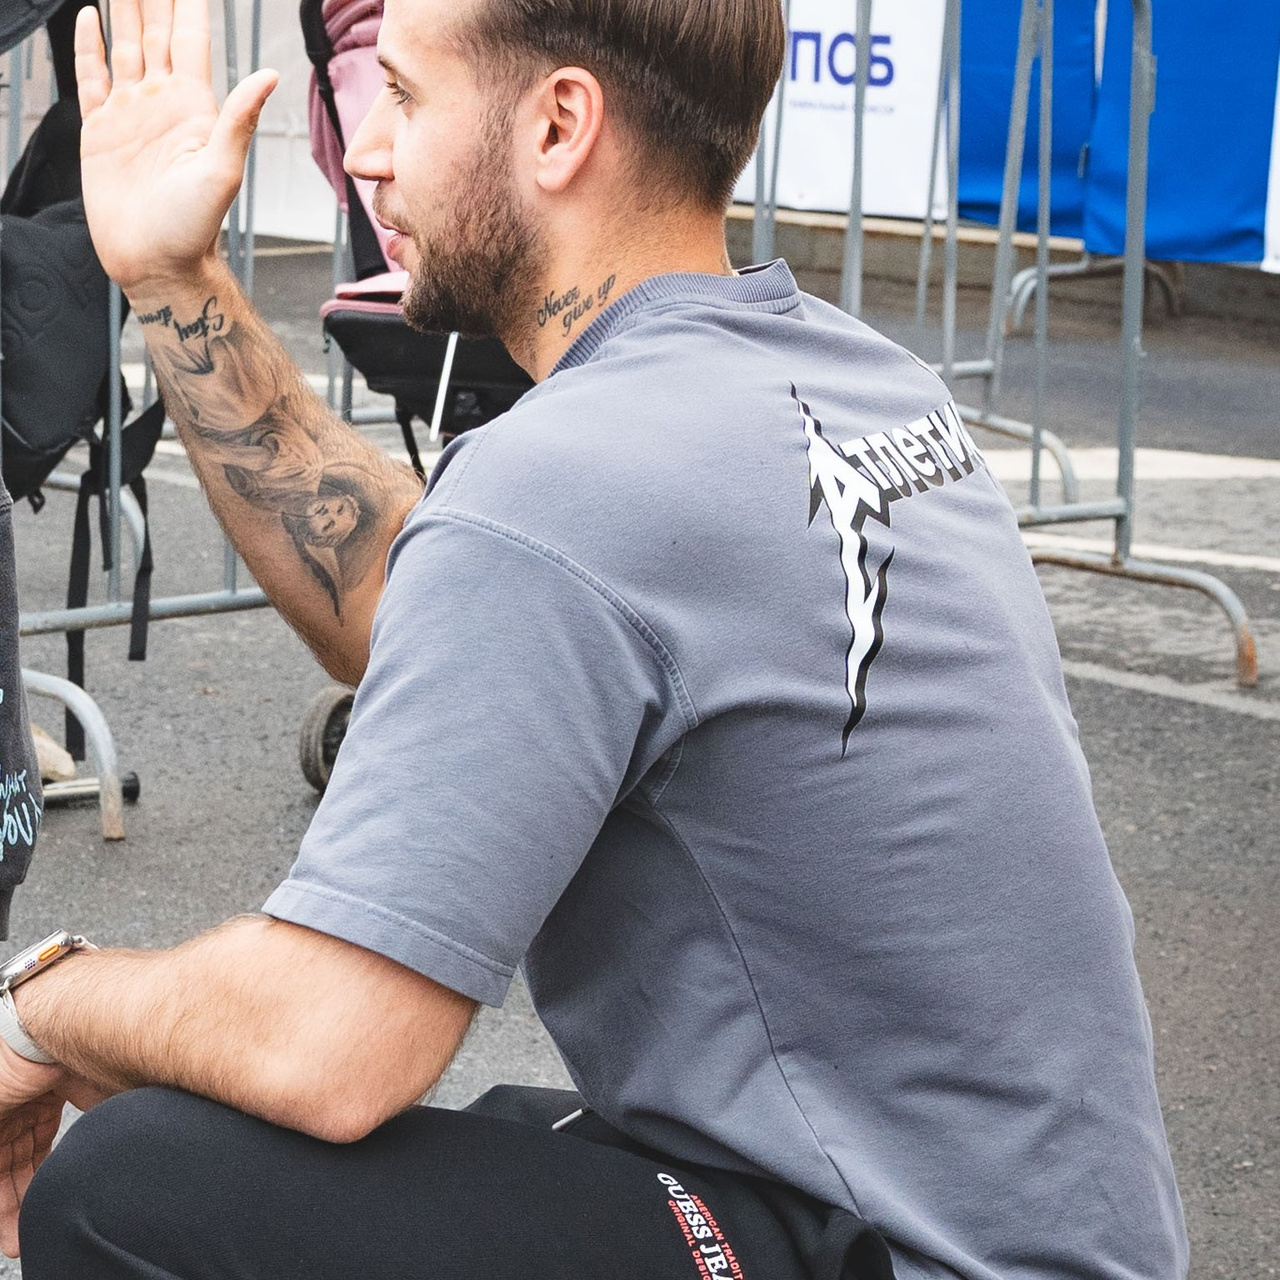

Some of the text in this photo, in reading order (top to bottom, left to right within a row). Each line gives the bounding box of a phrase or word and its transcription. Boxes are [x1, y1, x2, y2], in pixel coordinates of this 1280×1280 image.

[656, 1172, 714, 1240] GUESS
[667, 1199, 697, 1248] ORIGINAL
[689, 1193, 725, 1241] AMERICAN
